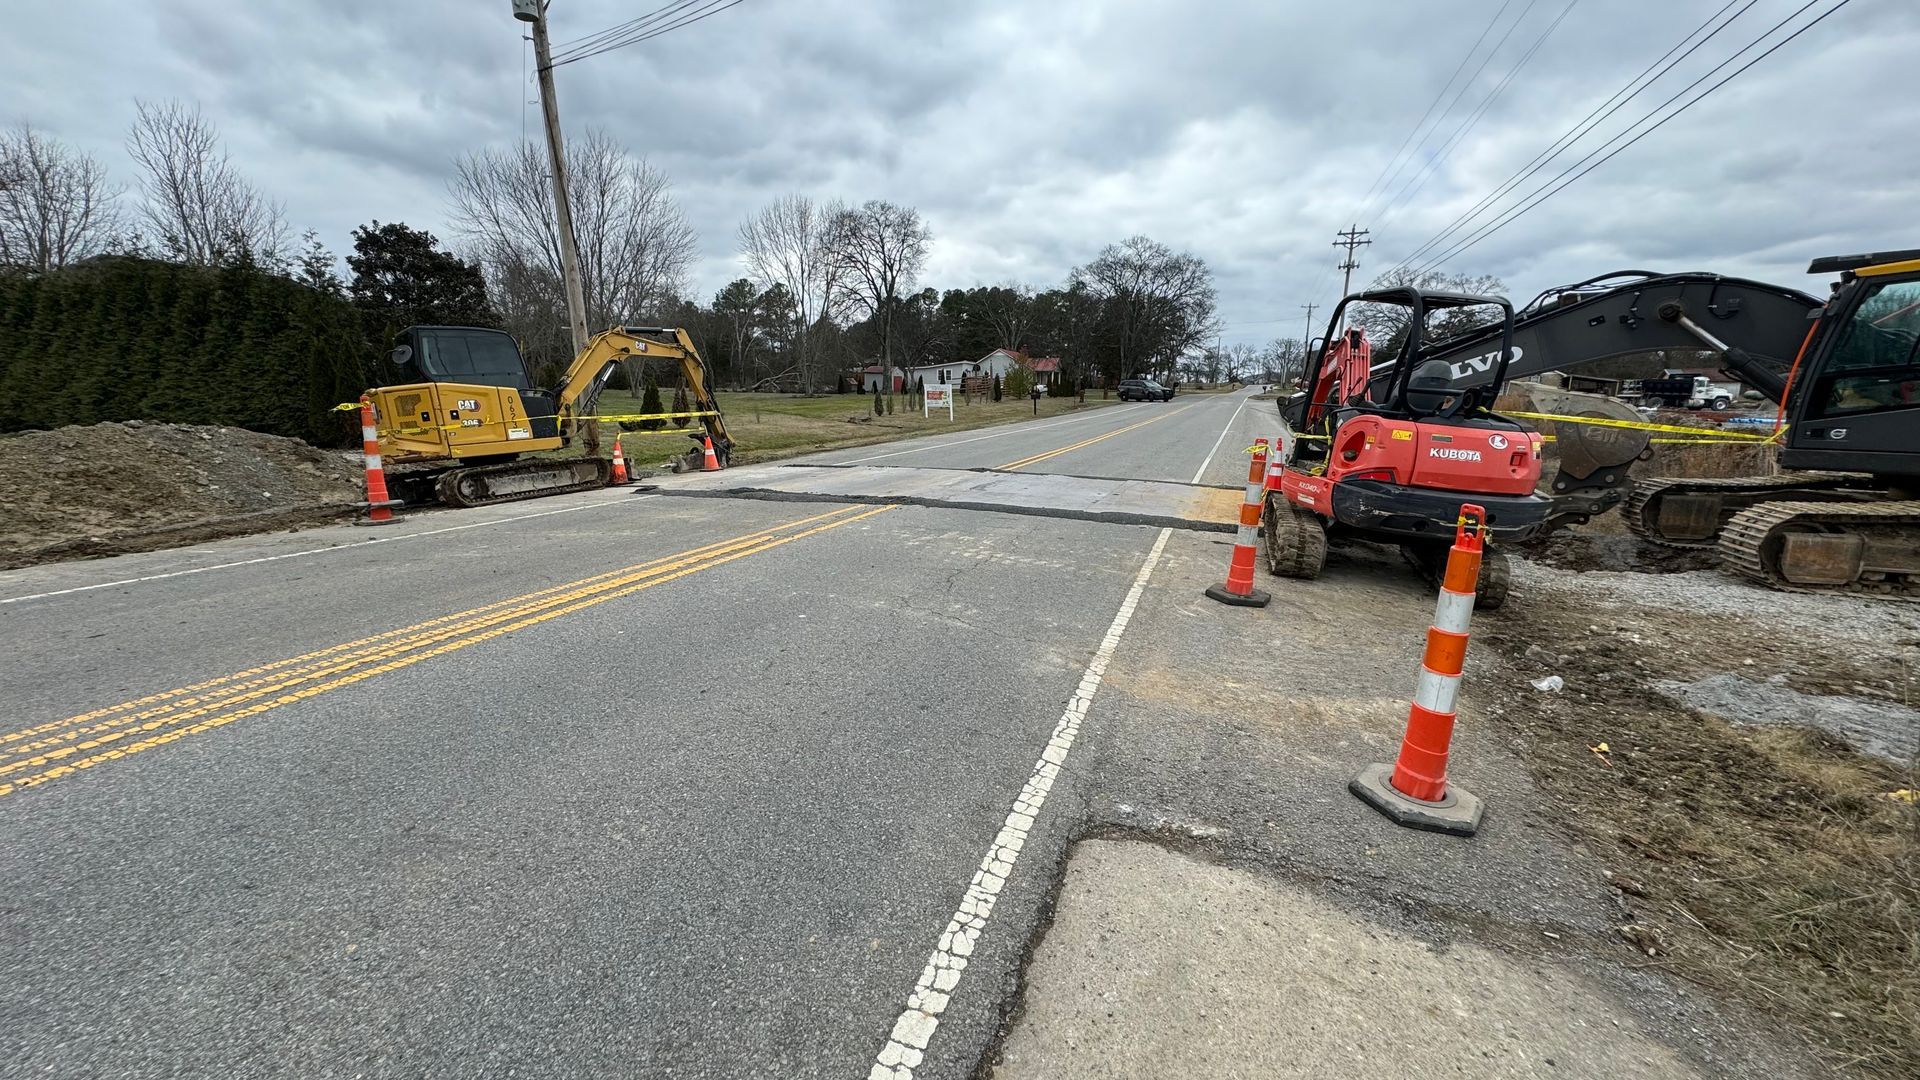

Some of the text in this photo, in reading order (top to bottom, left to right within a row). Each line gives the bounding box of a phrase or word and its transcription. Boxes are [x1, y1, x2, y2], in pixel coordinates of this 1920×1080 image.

[635, 340, 646, 351] CAT
[1450, 346, 1524, 380] LVO
[457, 399, 476, 411] CAT
[1430, 447, 1482, 462] KUBOTA
